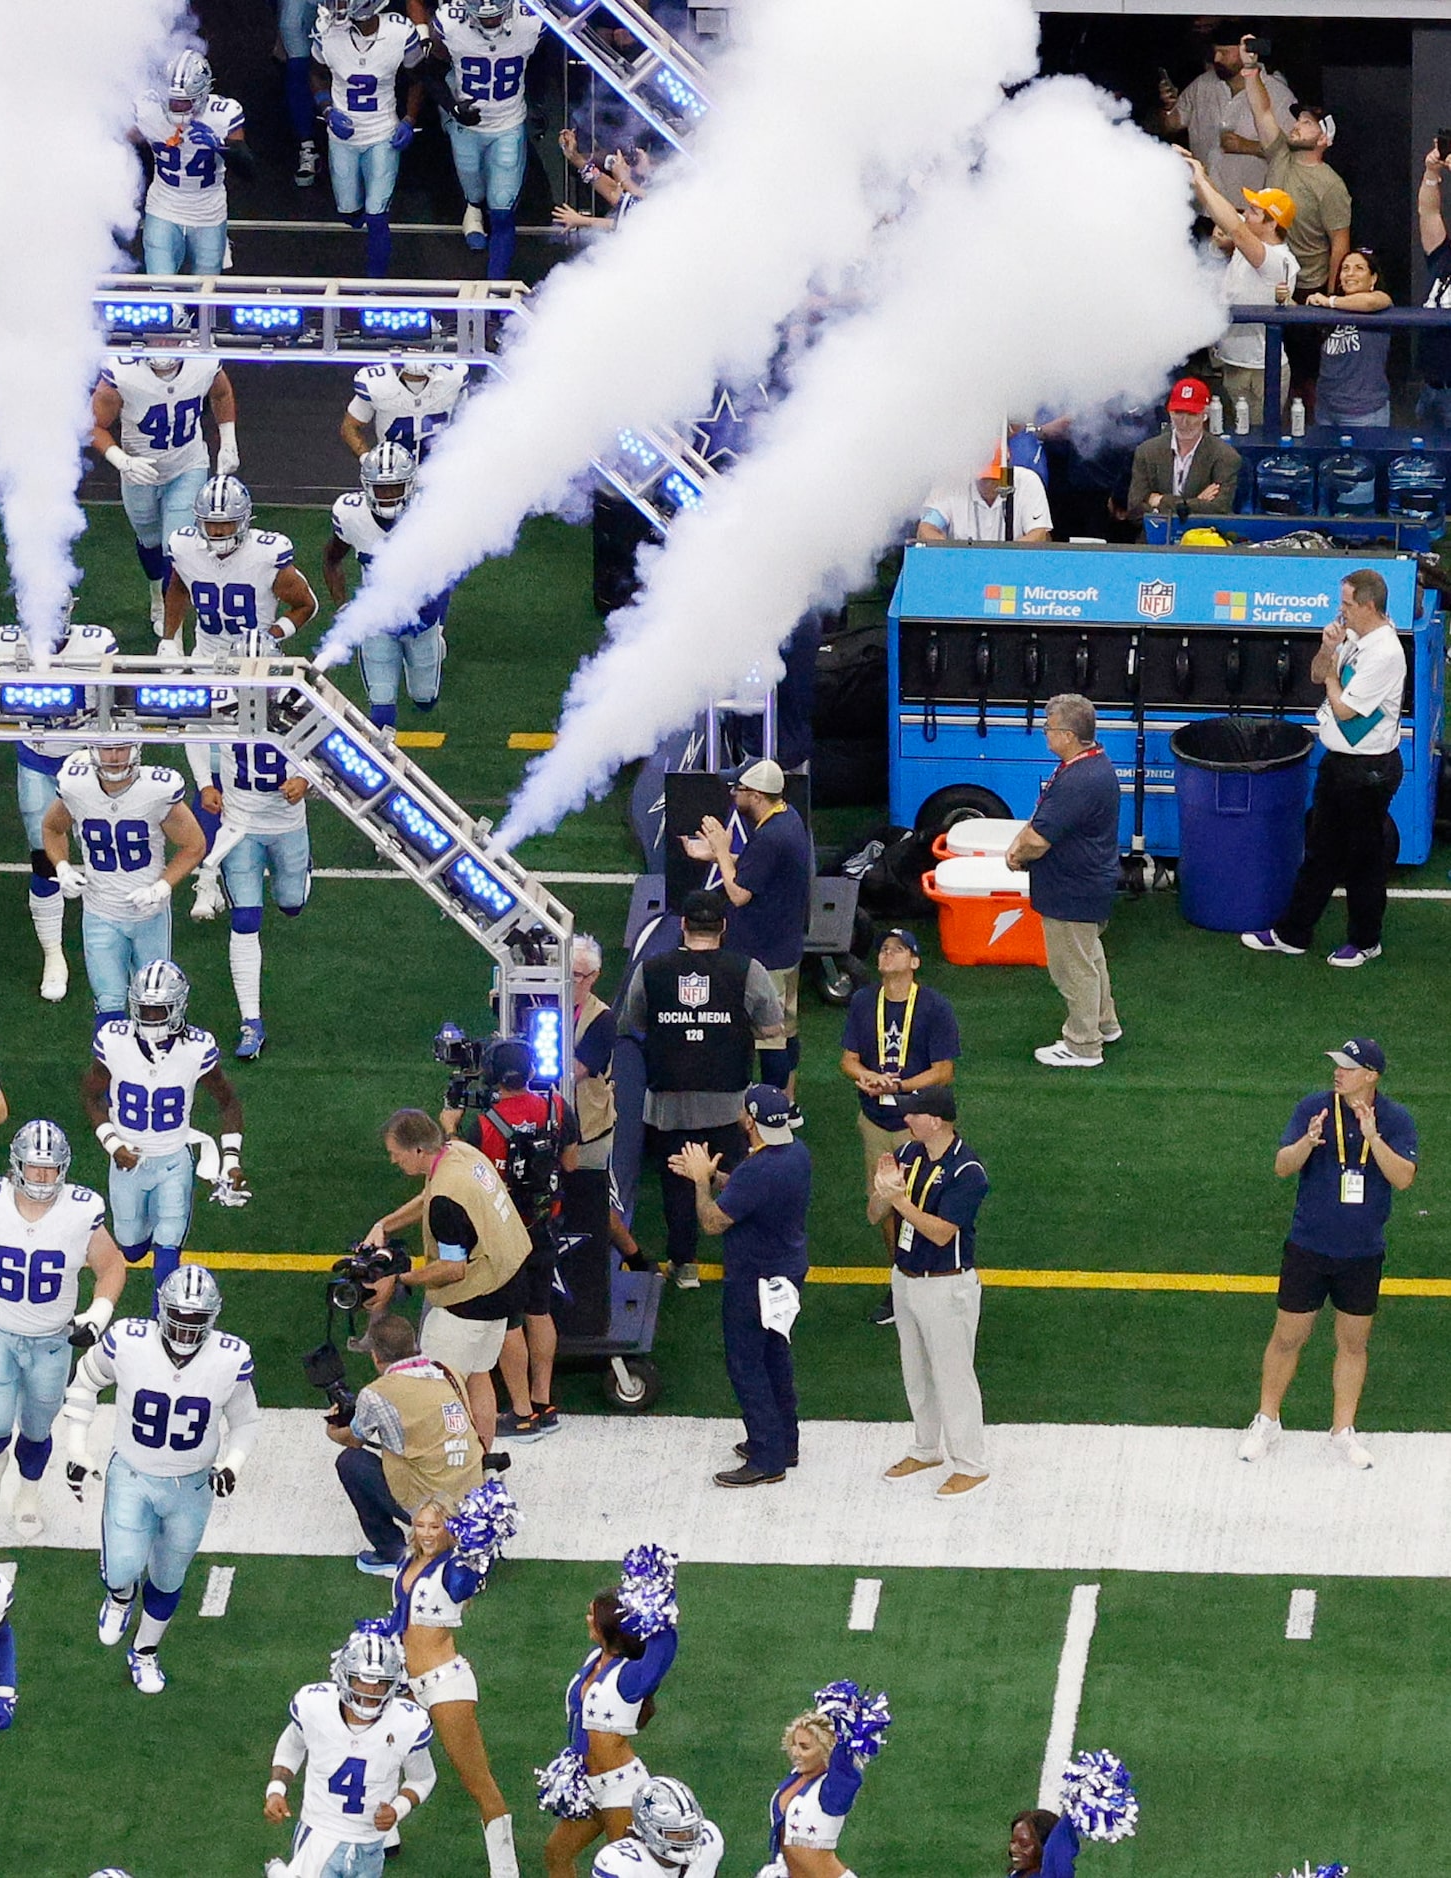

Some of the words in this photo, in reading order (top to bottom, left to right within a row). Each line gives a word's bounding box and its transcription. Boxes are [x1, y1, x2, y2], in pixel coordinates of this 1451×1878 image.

[347, 74, 378, 112] 2
[461, 56, 524, 101] 28
[152, 142, 217, 189] 24
[137, 395, 202, 450] 40
[191, 580, 258, 635] 89
[1022, 602, 1082, 617] Surface
[1024, 586, 1099, 602] Microsoft
[1143, 597, 1170, 613] NFL
[1252, 608, 1313, 623] Surface
[1254, 592, 1330, 608] Microsoft
[232, 743, 289, 792] 19
[82, 818, 152, 873] 86
[657, 1011, 696, 1024] SOCIAL
[697, 1011, 732, 1024] MEDIA
[685, 1029, 704, 1041] 128
[117, 1080, 185, 1132] 88
[132, 1388, 211, 1451] 93
[328, 1756, 367, 1814] 4
